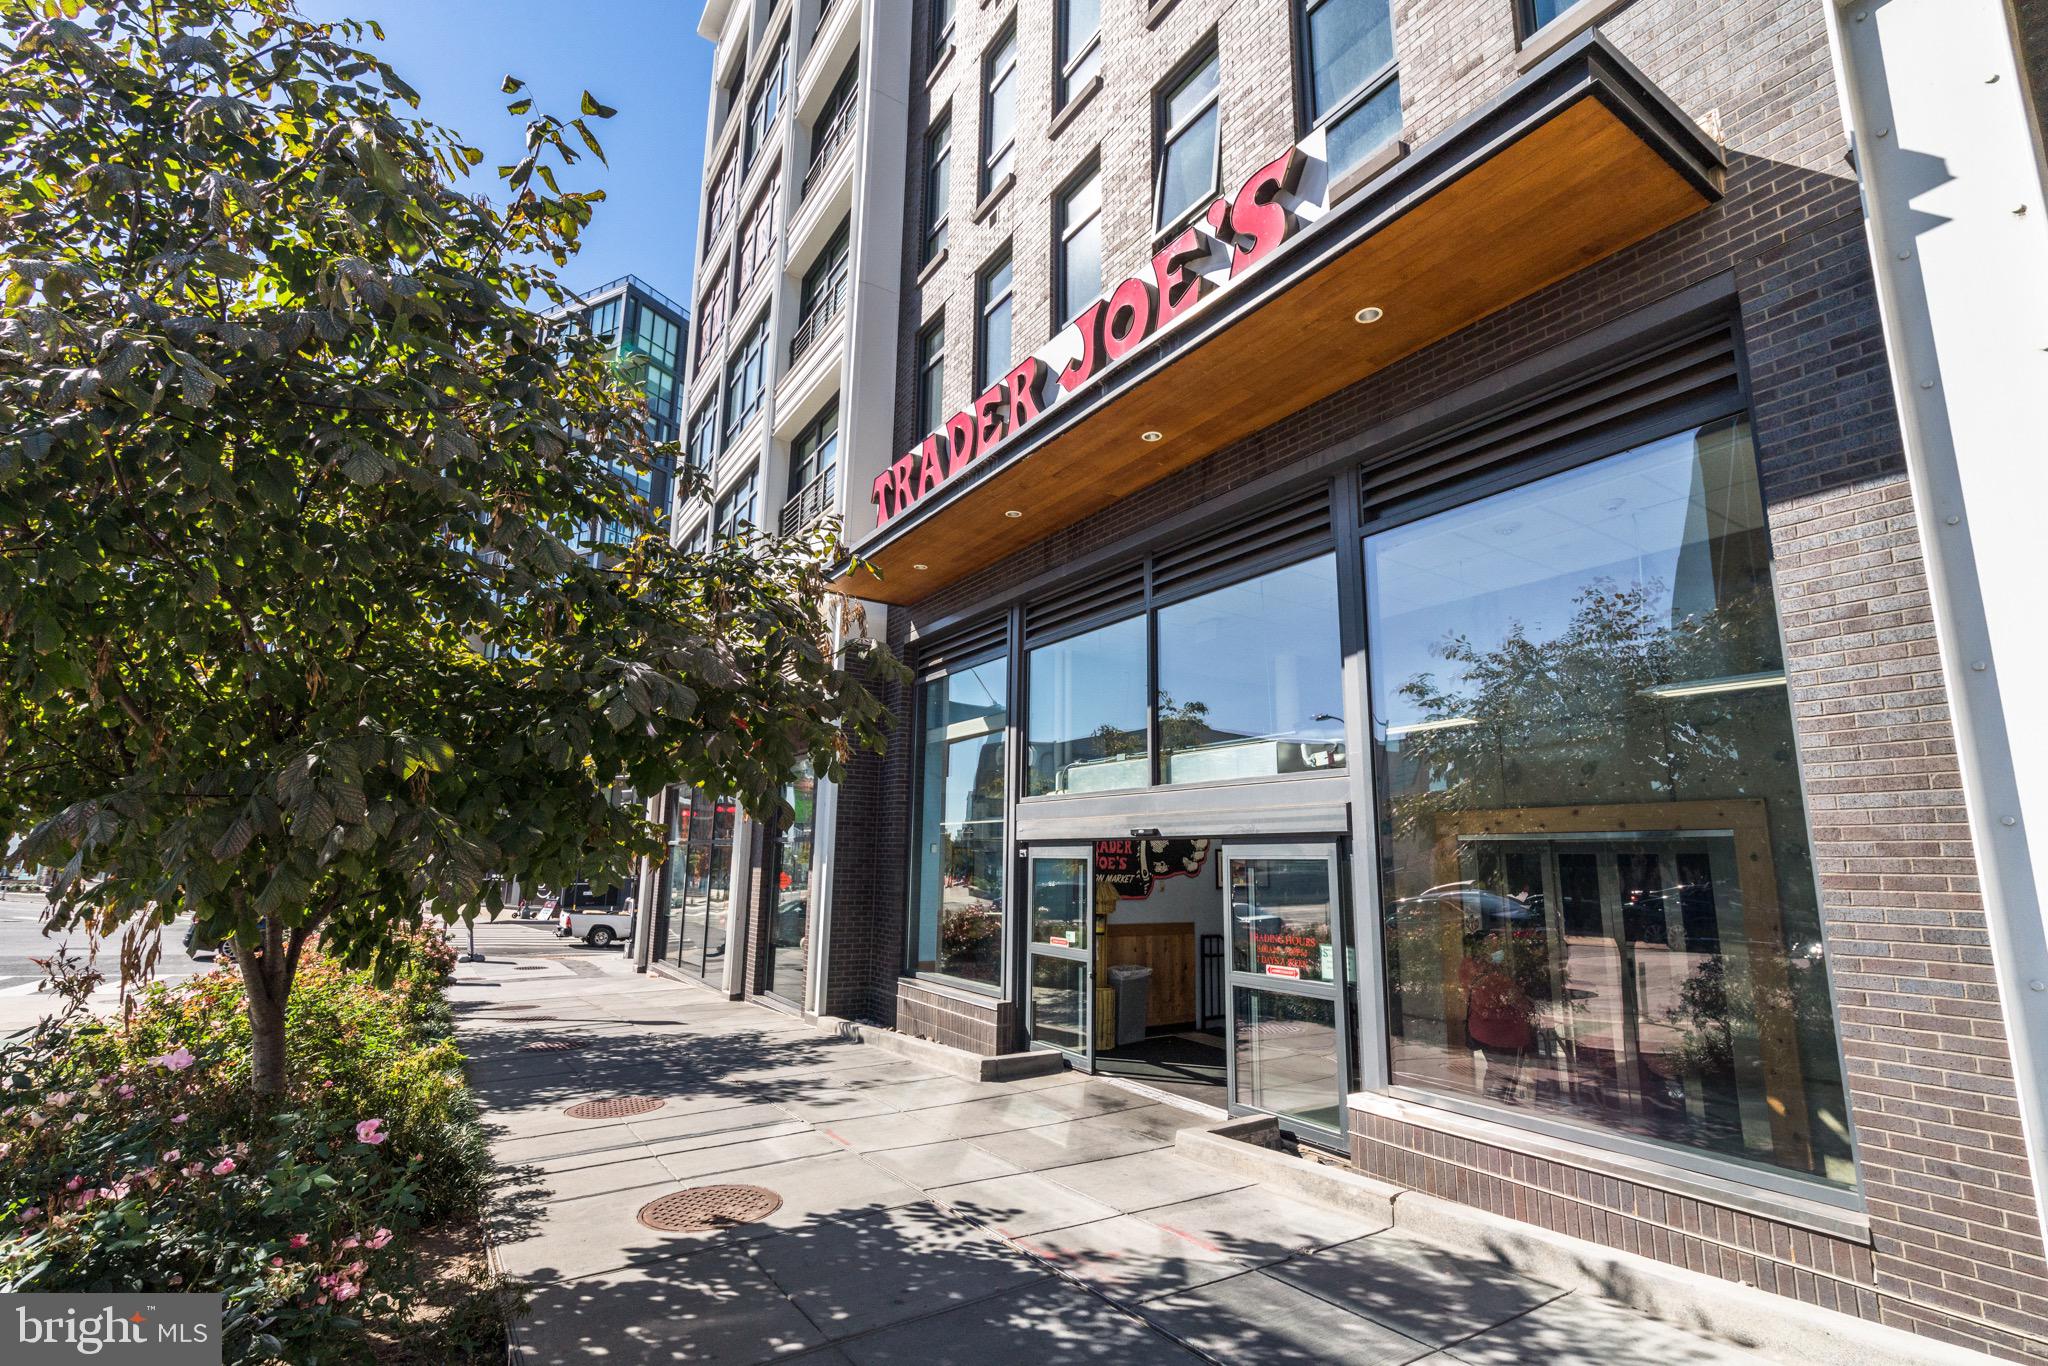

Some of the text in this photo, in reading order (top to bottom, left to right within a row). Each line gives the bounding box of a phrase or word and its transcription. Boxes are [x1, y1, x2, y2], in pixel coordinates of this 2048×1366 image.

[871, 145, 1304, 529] TRADER JOE'S
[1096, 839, 1132, 854] ADER
[1105, 874, 1135, 884] MARKET
[1250, 931, 1317, 948] TRADING HOURS
